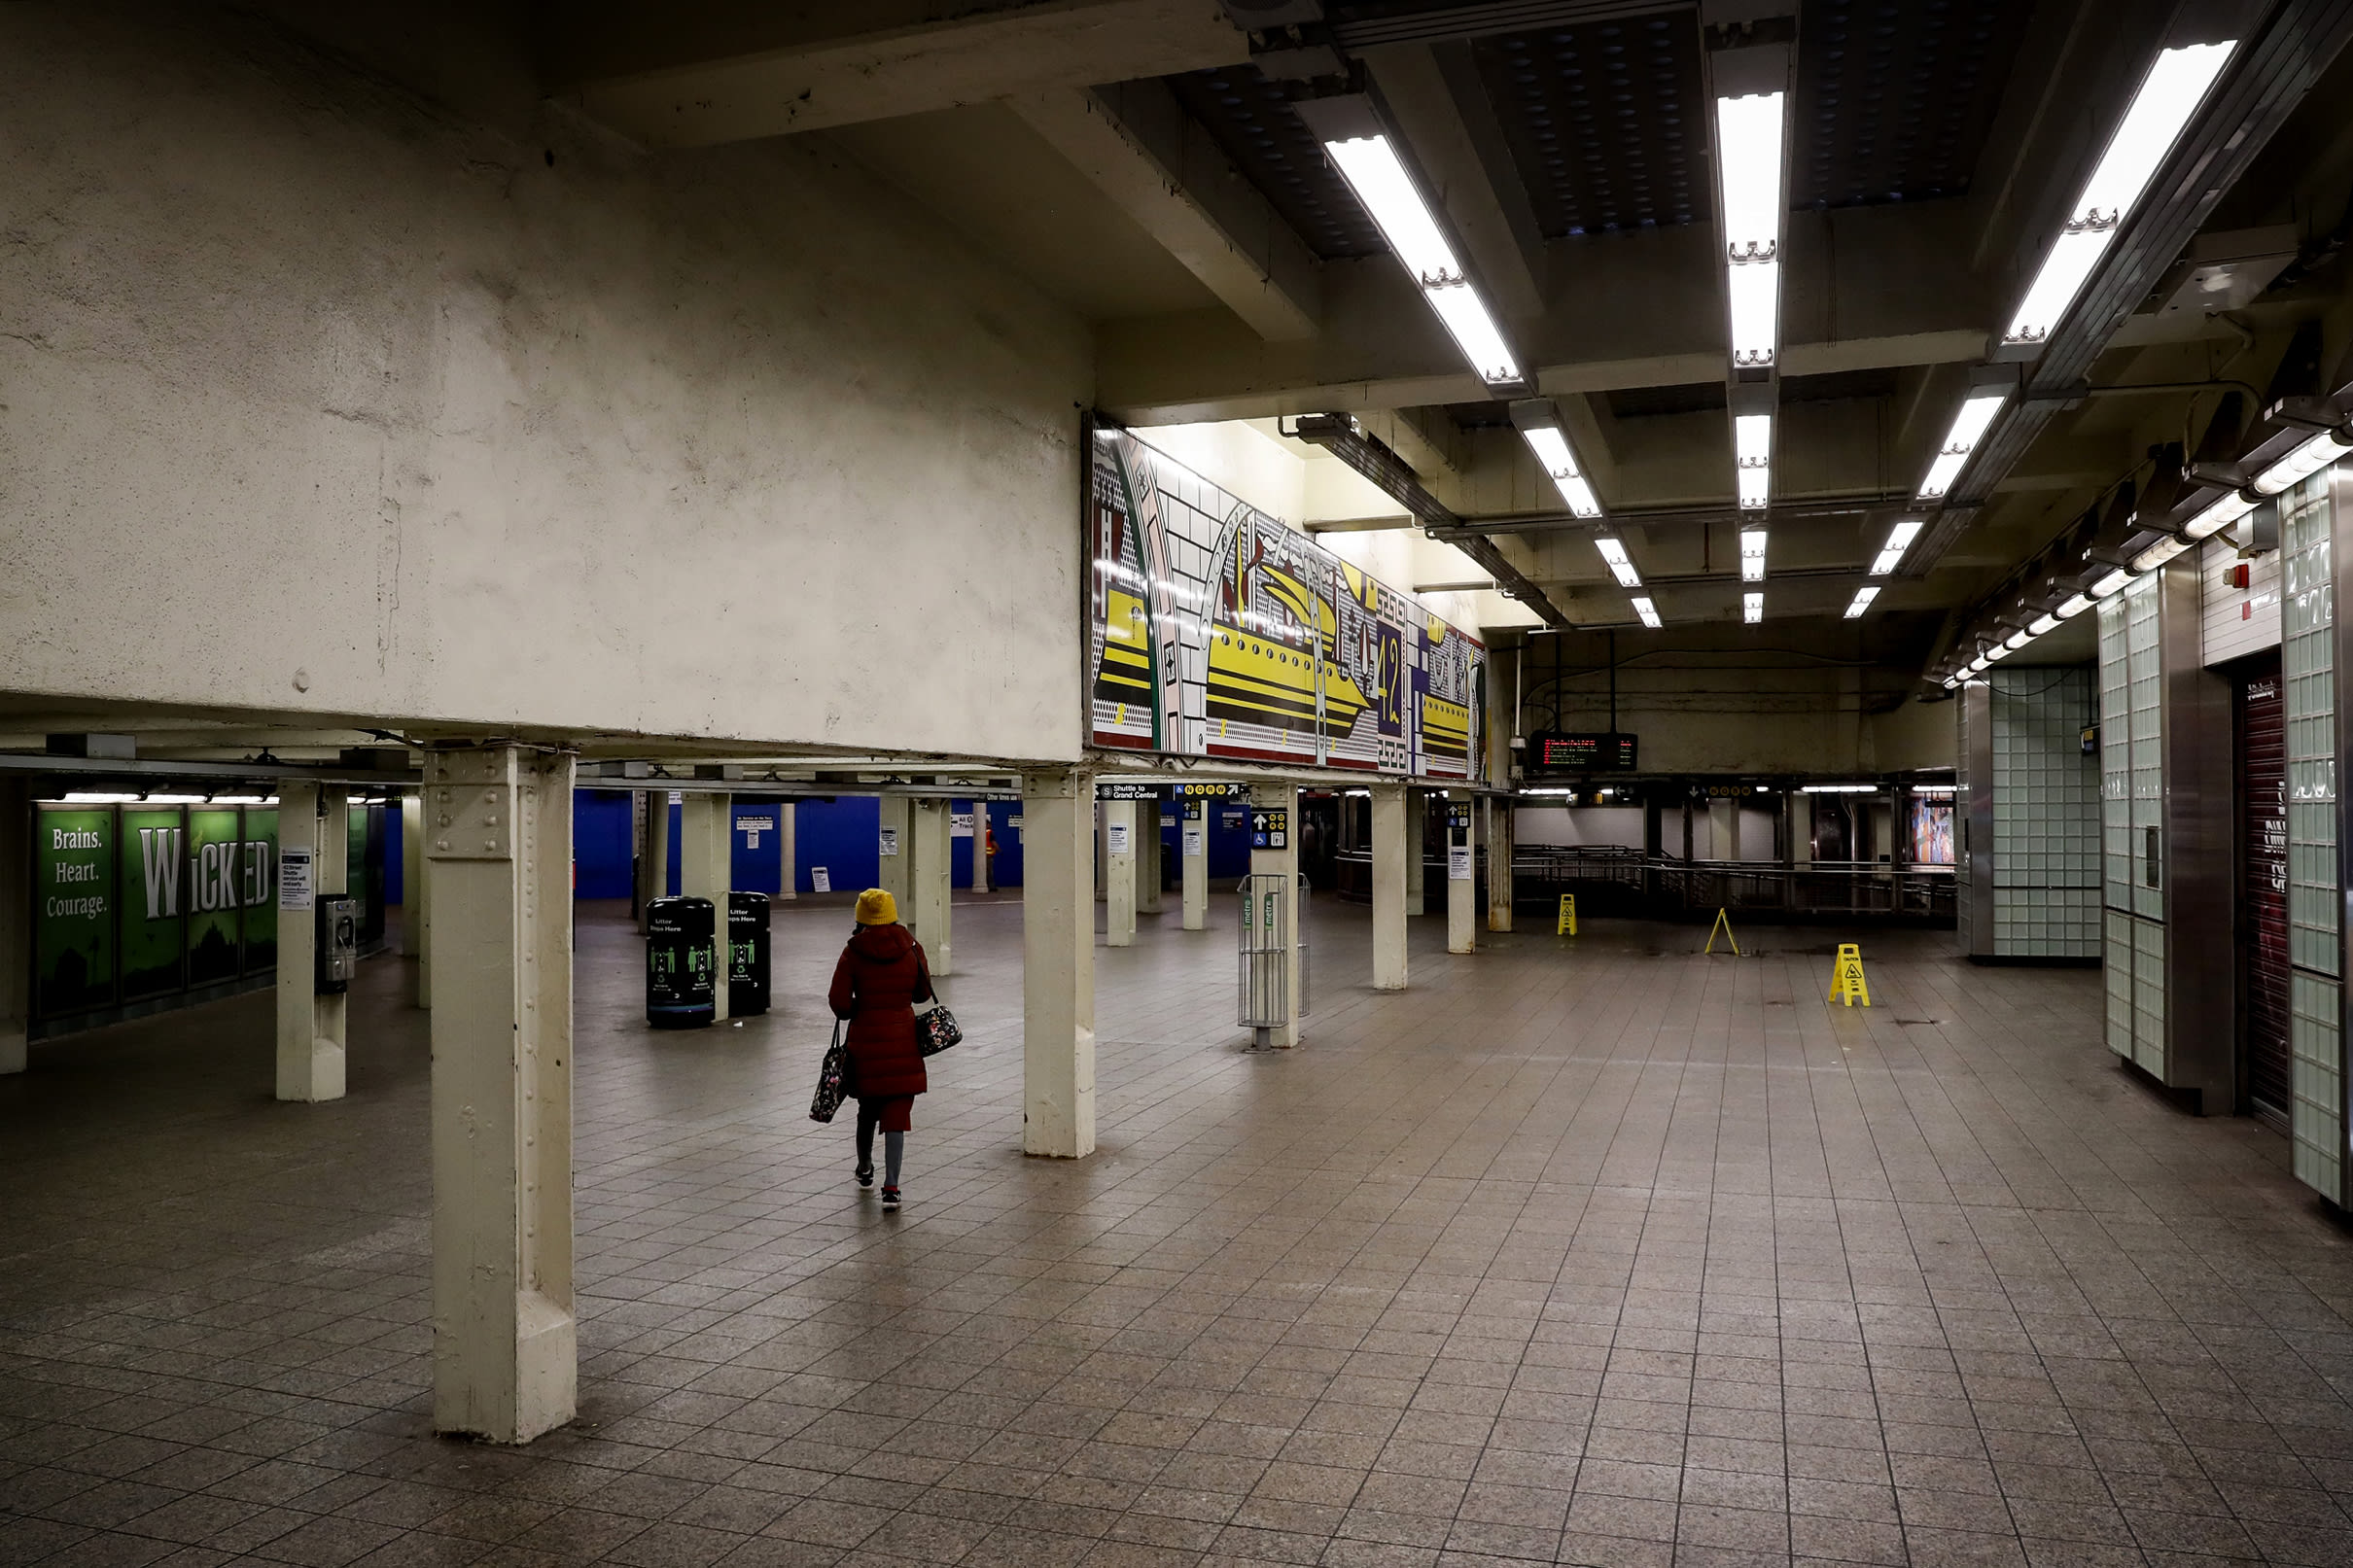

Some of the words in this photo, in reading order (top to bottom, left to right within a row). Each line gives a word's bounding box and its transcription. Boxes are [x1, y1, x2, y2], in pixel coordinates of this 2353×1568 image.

[1378, 633, 1401, 725] 42
[53, 828, 102, 851] Brains.
[54, 861, 100, 884] Heart.
[46, 894, 108, 920] Courage.
